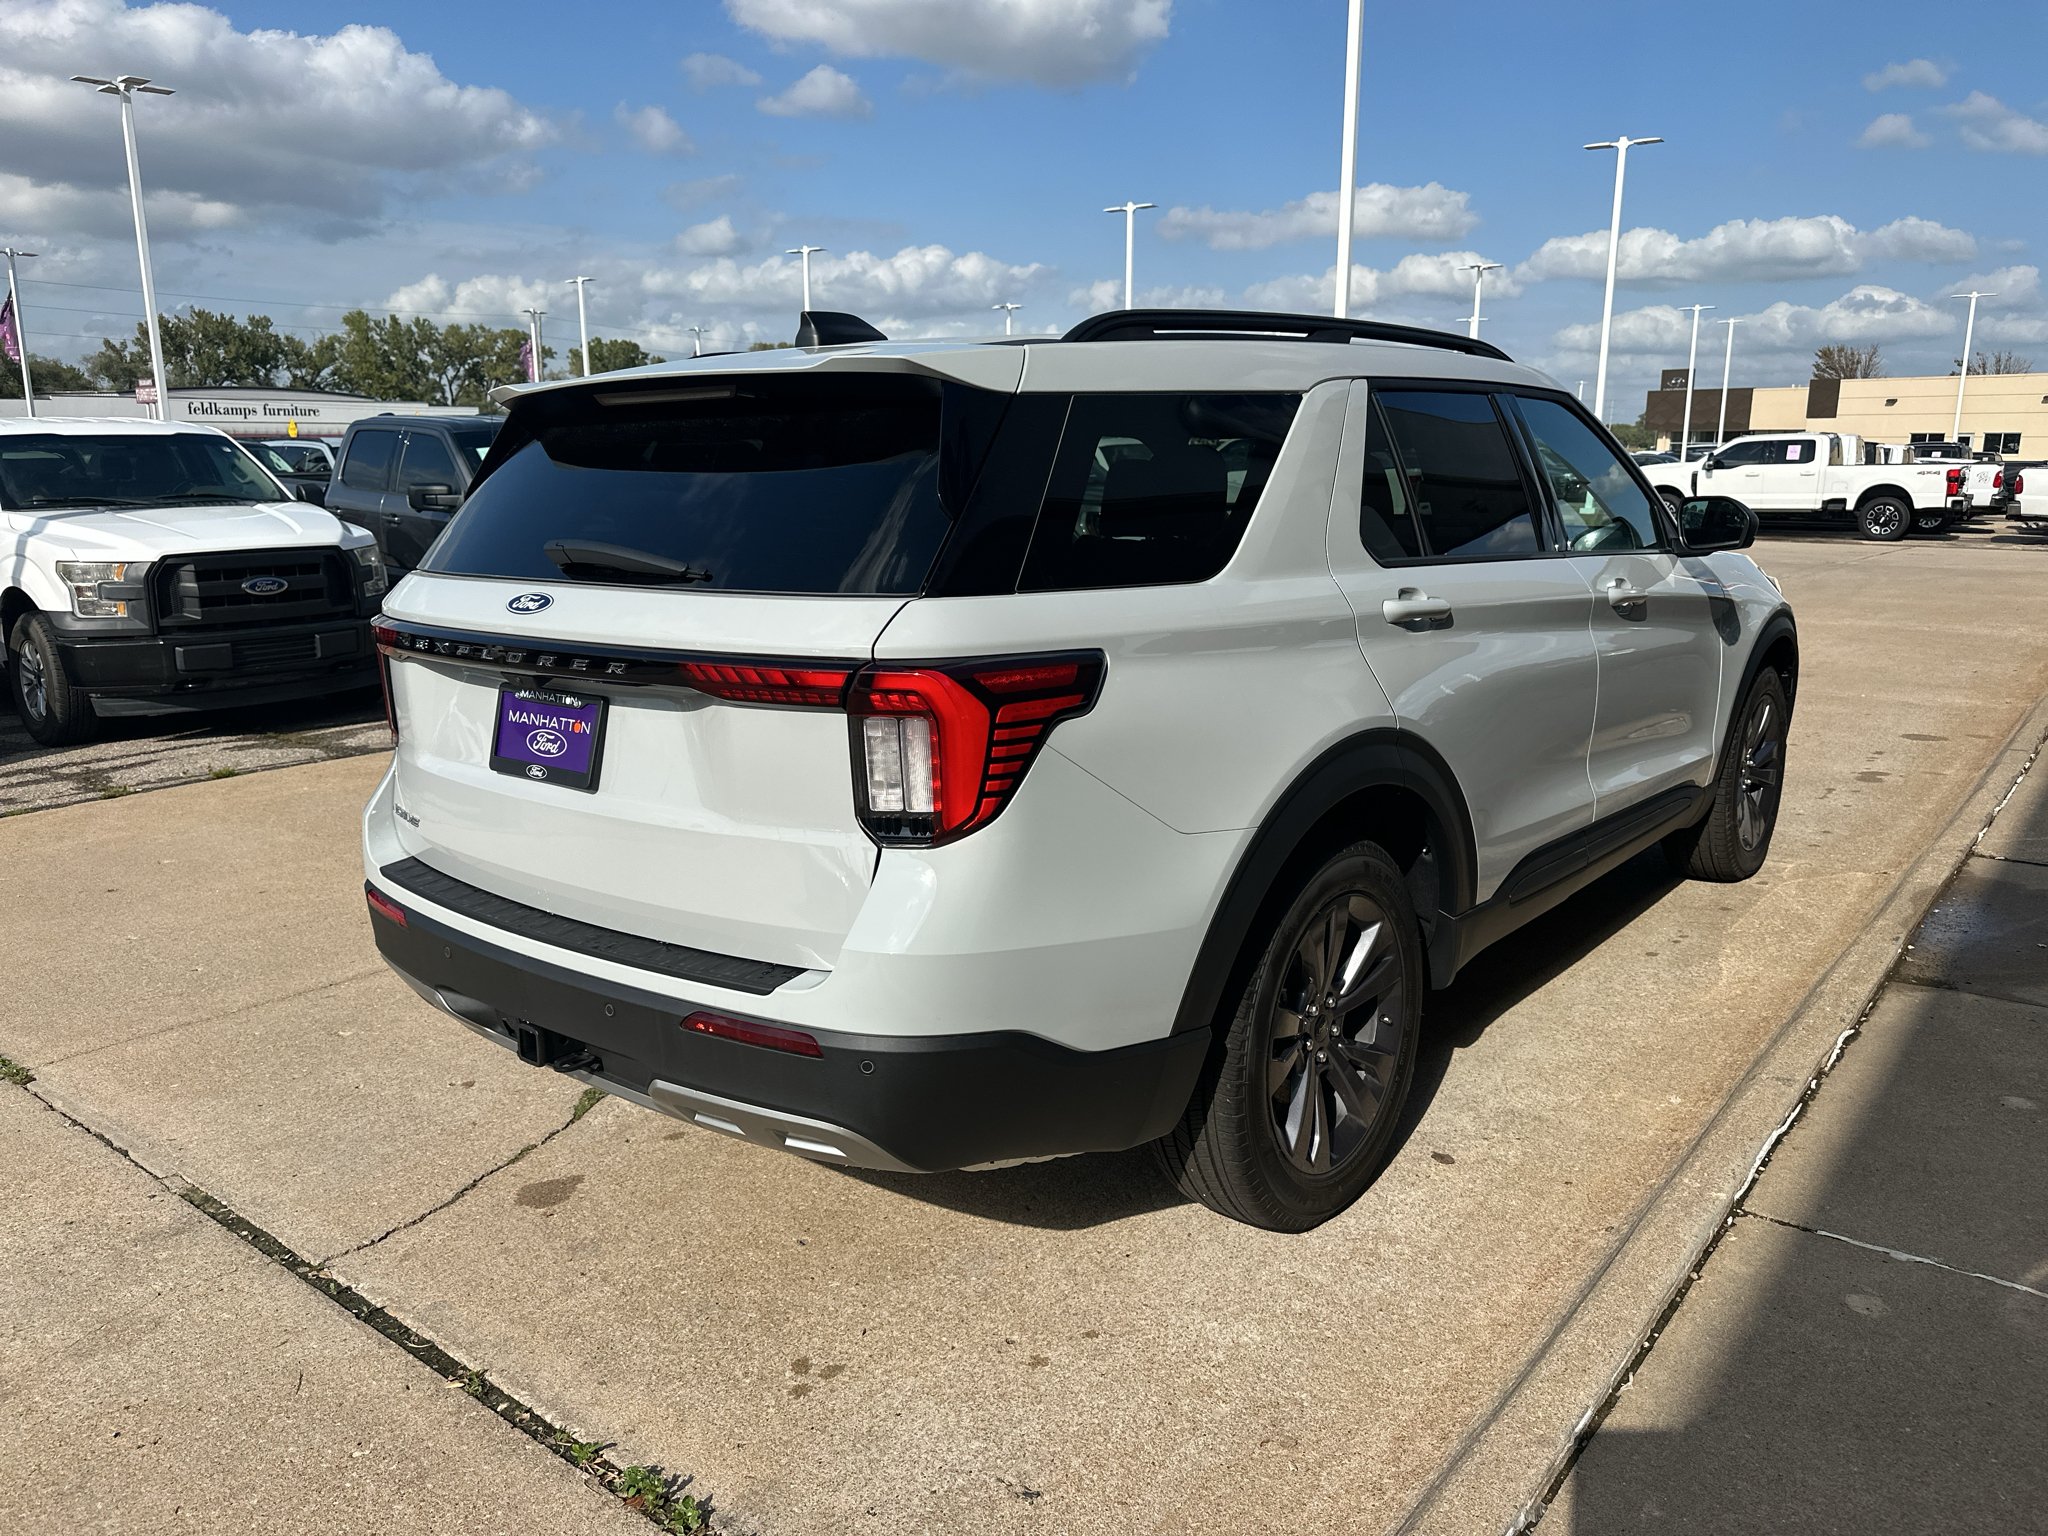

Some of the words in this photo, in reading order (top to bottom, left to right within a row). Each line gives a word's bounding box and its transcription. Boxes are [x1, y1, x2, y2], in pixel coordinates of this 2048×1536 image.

[188, 402, 258, 420] feldkamps
[263, 403, 320, 417] furniture
[512, 594, 547, 611] Ford
[532, 732, 561, 754] Ford
